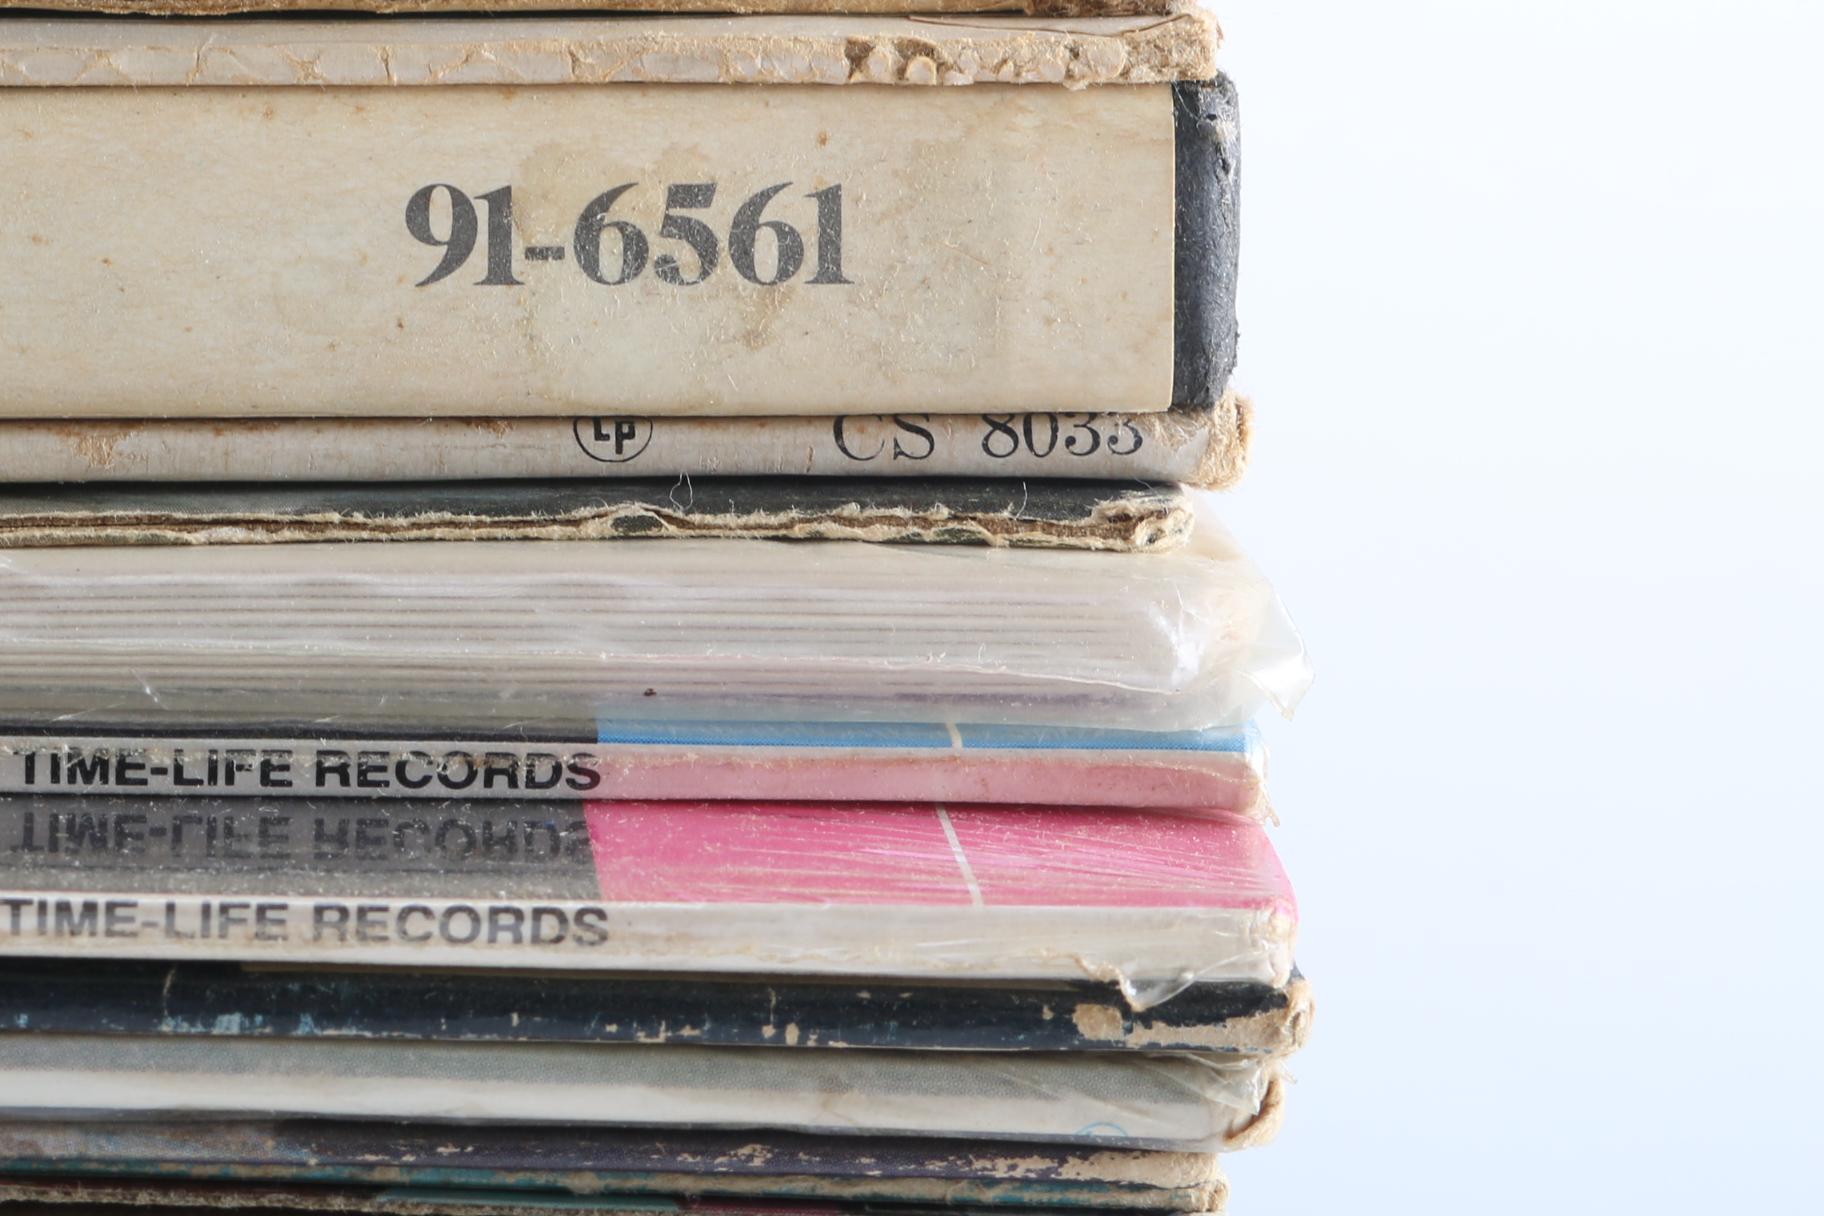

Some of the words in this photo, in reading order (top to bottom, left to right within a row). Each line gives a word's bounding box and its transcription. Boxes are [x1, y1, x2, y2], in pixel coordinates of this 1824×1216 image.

[405, 181, 856, 287] 91-6561
[832, 414, 936, 461] CS
[980, 413, 1144, 459] 8033
[12, 747, 294, 787] TIME-LIFE
[315, 750, 602, 790] RECORDS
[312, 903, 610, 946] RECORDS
